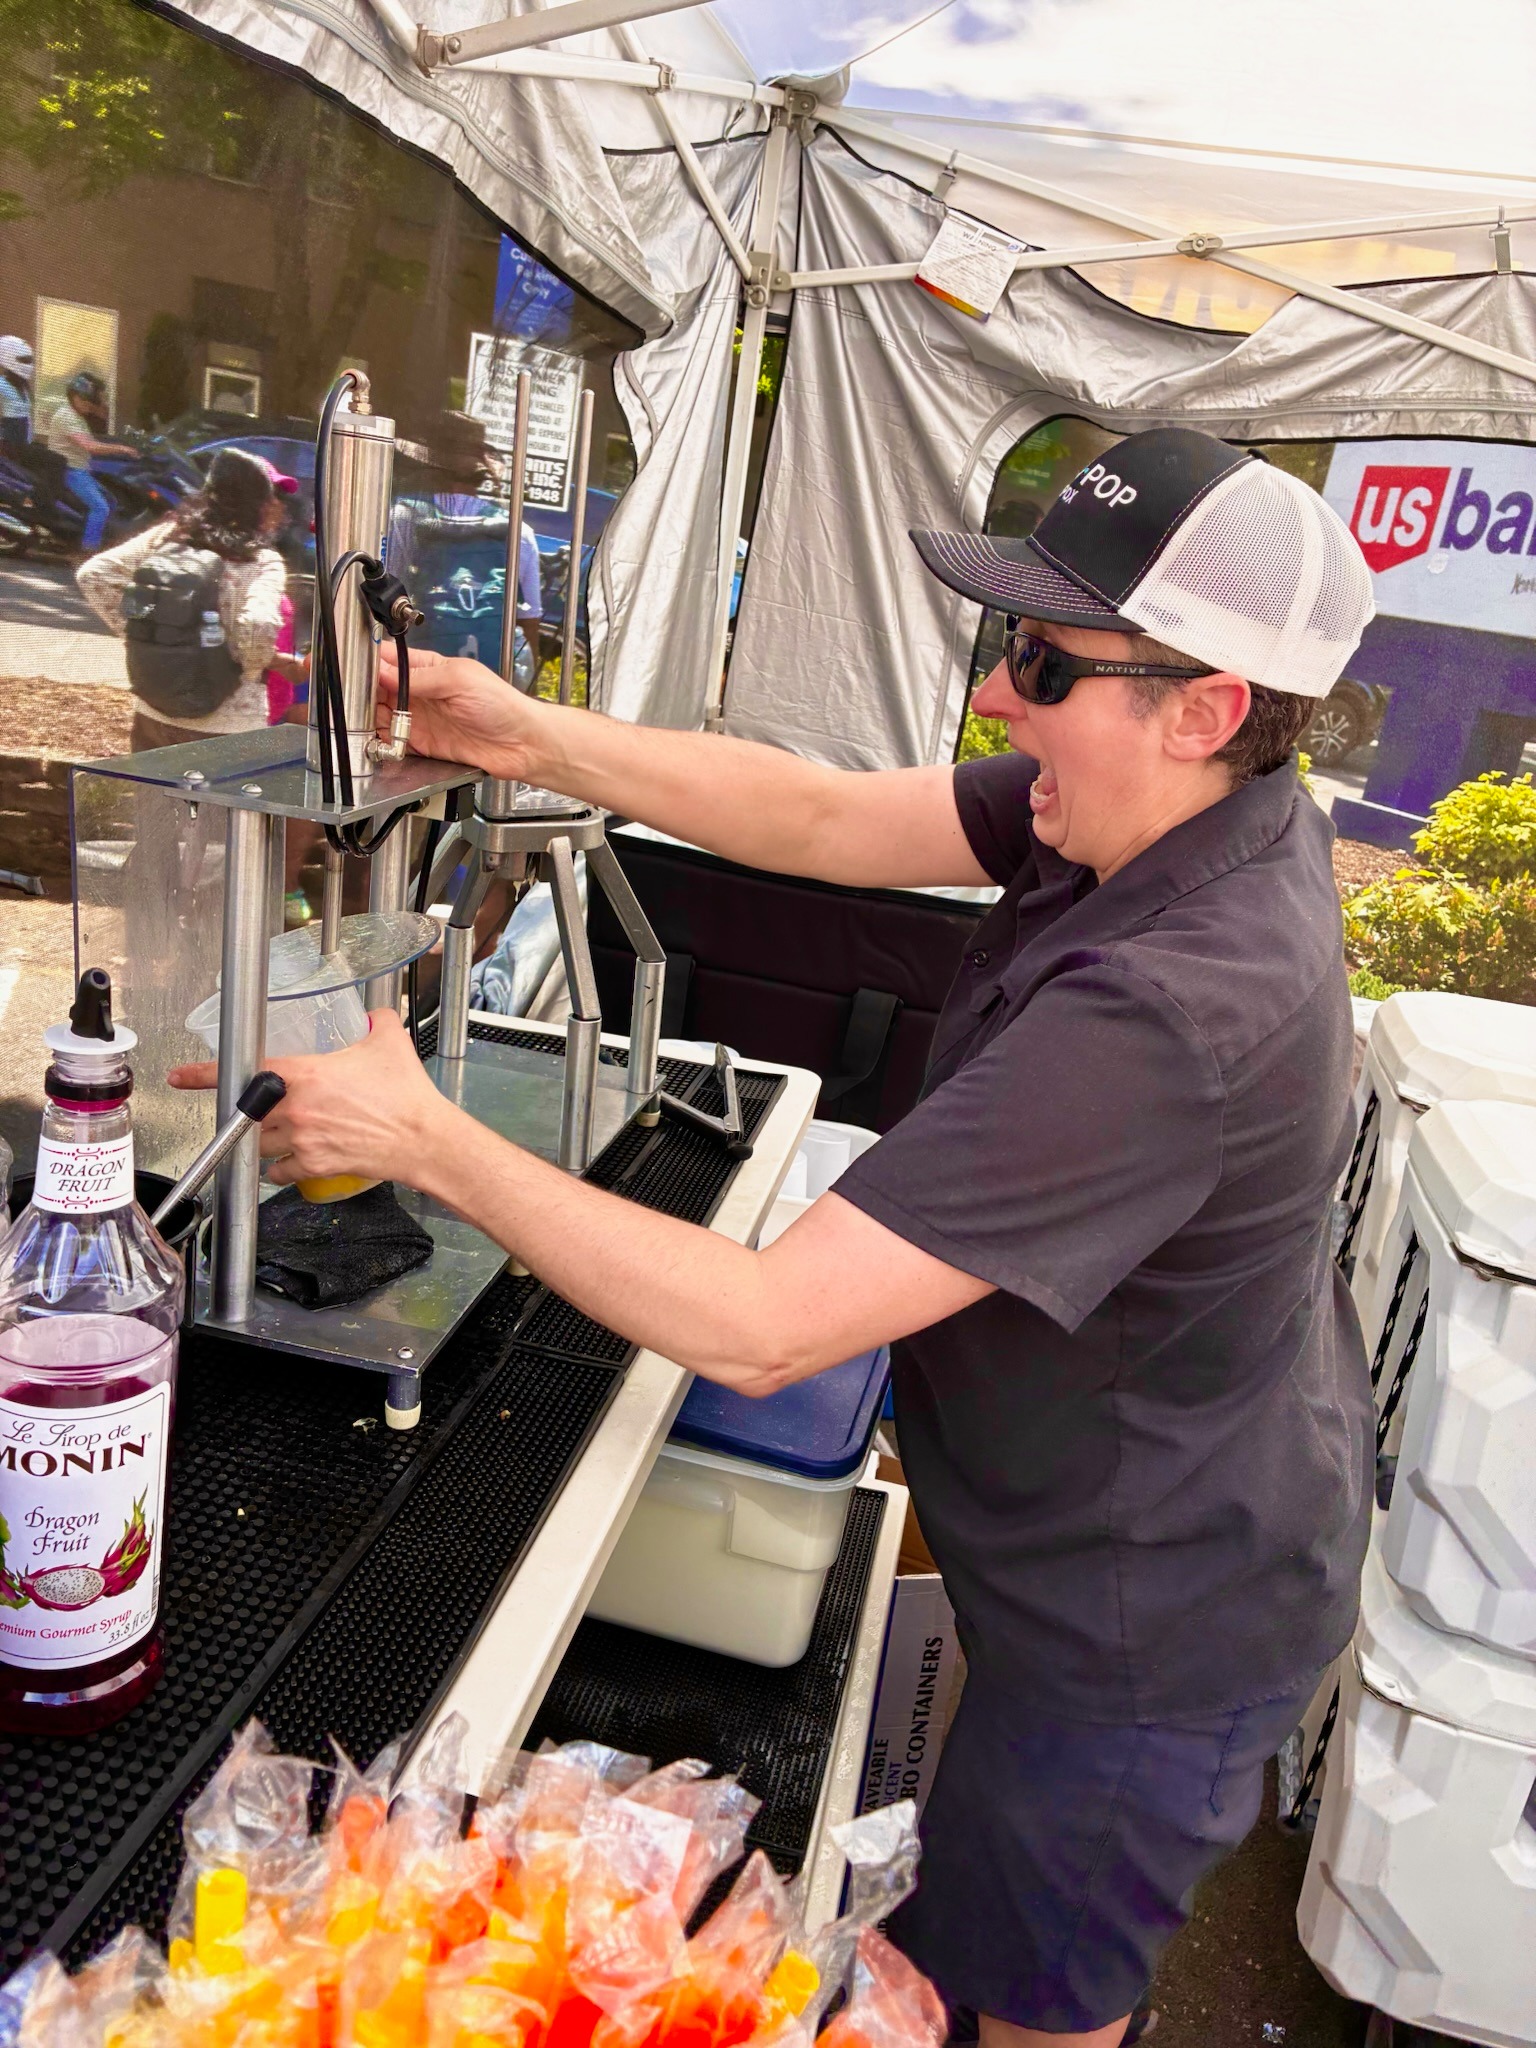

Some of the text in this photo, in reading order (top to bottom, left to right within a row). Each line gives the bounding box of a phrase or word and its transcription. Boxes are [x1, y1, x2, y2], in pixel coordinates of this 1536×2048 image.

[961, 231, 998, 252] WANING
[1439, 467, 1536, 556] ba
[1095, 665, 1146, 675] NATIVE
[49, 1157, 126, 1177] DRAGON
[57, 1176, 115, 1193] FRUIT
[2, 1420, 132, 1451] Le Sirop de
[24, 1505, 100, 1536] Dragon
[32, 1529, 90, 1556] Fruit
[0, 1608, 132, 1640] emium Gourmet Syrup
[108, 1622, 130, 1645] 33.8
[901, 1636, 944, 1799] BO CONTAINERS
[881, 1761, 902, 1806] UCENT
